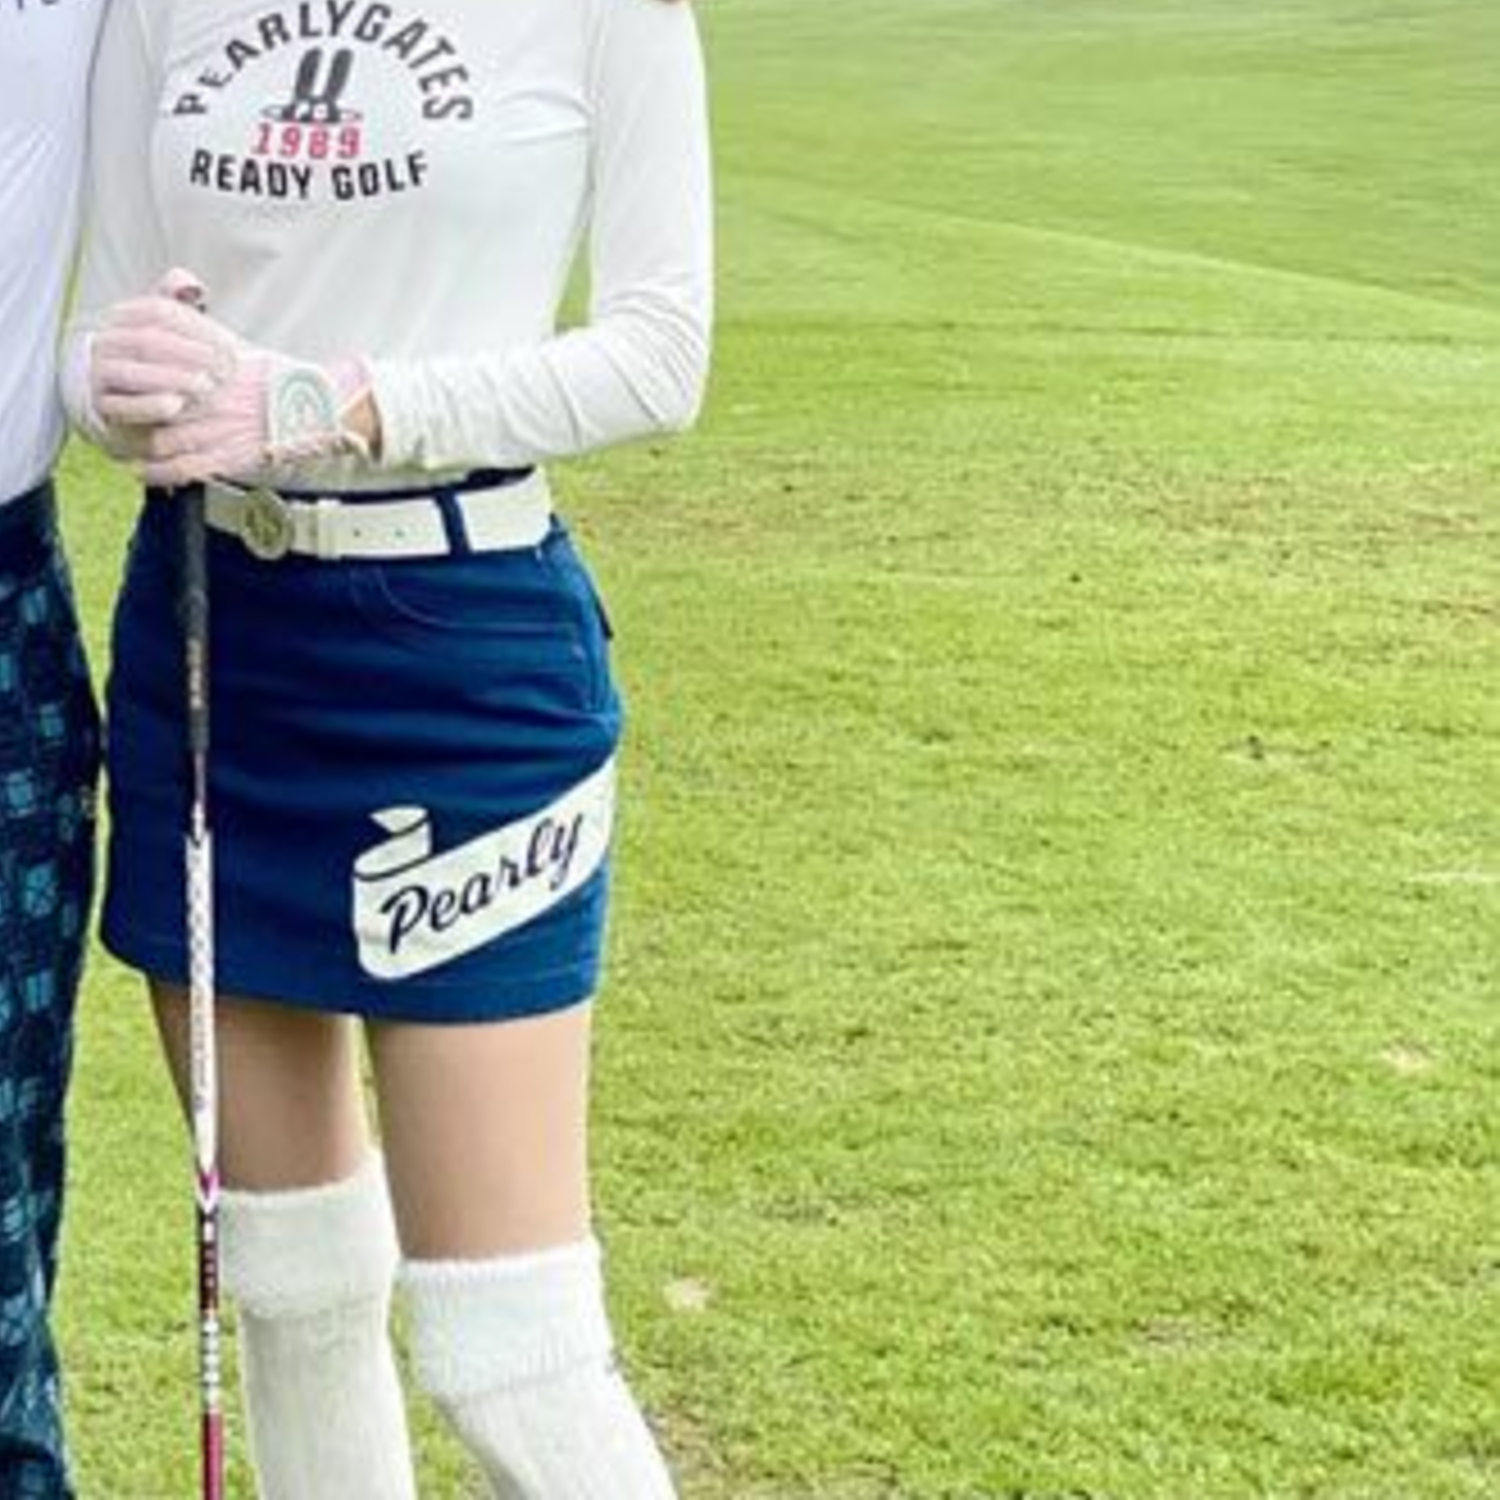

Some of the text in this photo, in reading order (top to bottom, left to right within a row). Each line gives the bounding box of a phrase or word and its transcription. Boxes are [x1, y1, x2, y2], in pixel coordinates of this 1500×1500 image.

[253, 122, 362, 160] 1989
[189, 148, 428, 201] READY GOLF
[379, 813, 583, 955] Pearly
